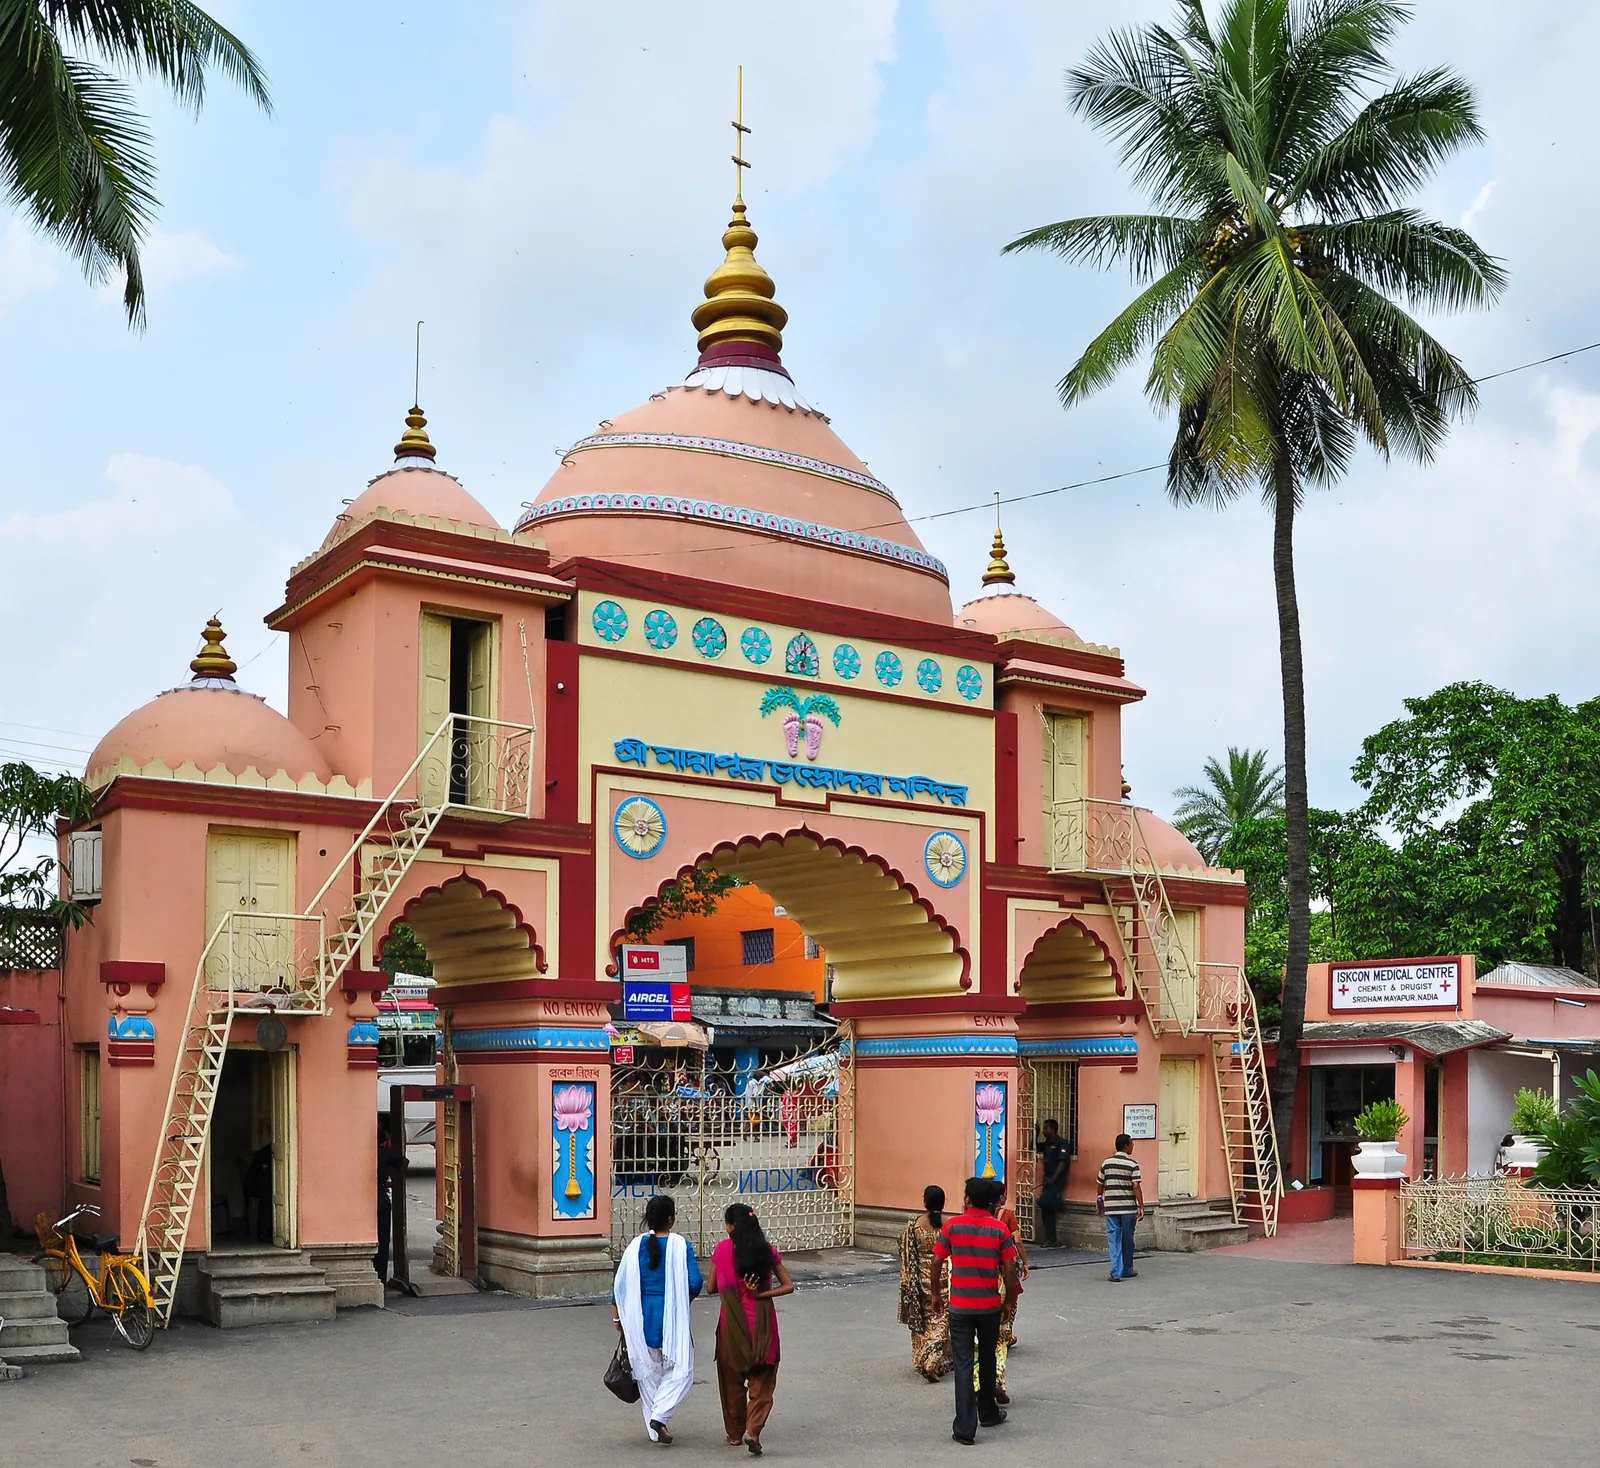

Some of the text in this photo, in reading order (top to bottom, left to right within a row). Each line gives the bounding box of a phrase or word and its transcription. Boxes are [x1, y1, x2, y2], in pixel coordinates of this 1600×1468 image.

[614, 737, 968, 807] শ্রী মায়াপুর চন্দ্রোদয় মন্দির
[1337, 966, 1454, 983] ISKCON MEDICAL CENTRE
[1357, 985, 1387, 993] CHEMIST
[1400, 983, 1433, 991] DRUGIST
[628, 993, 669, 1003] AIRCEL
[1352, 996, 1382, 1004] SRIDHAM
[543, 1001, 602, 1017] NO ENTRY
[974, 1015, 1006, 1027] EXIT
